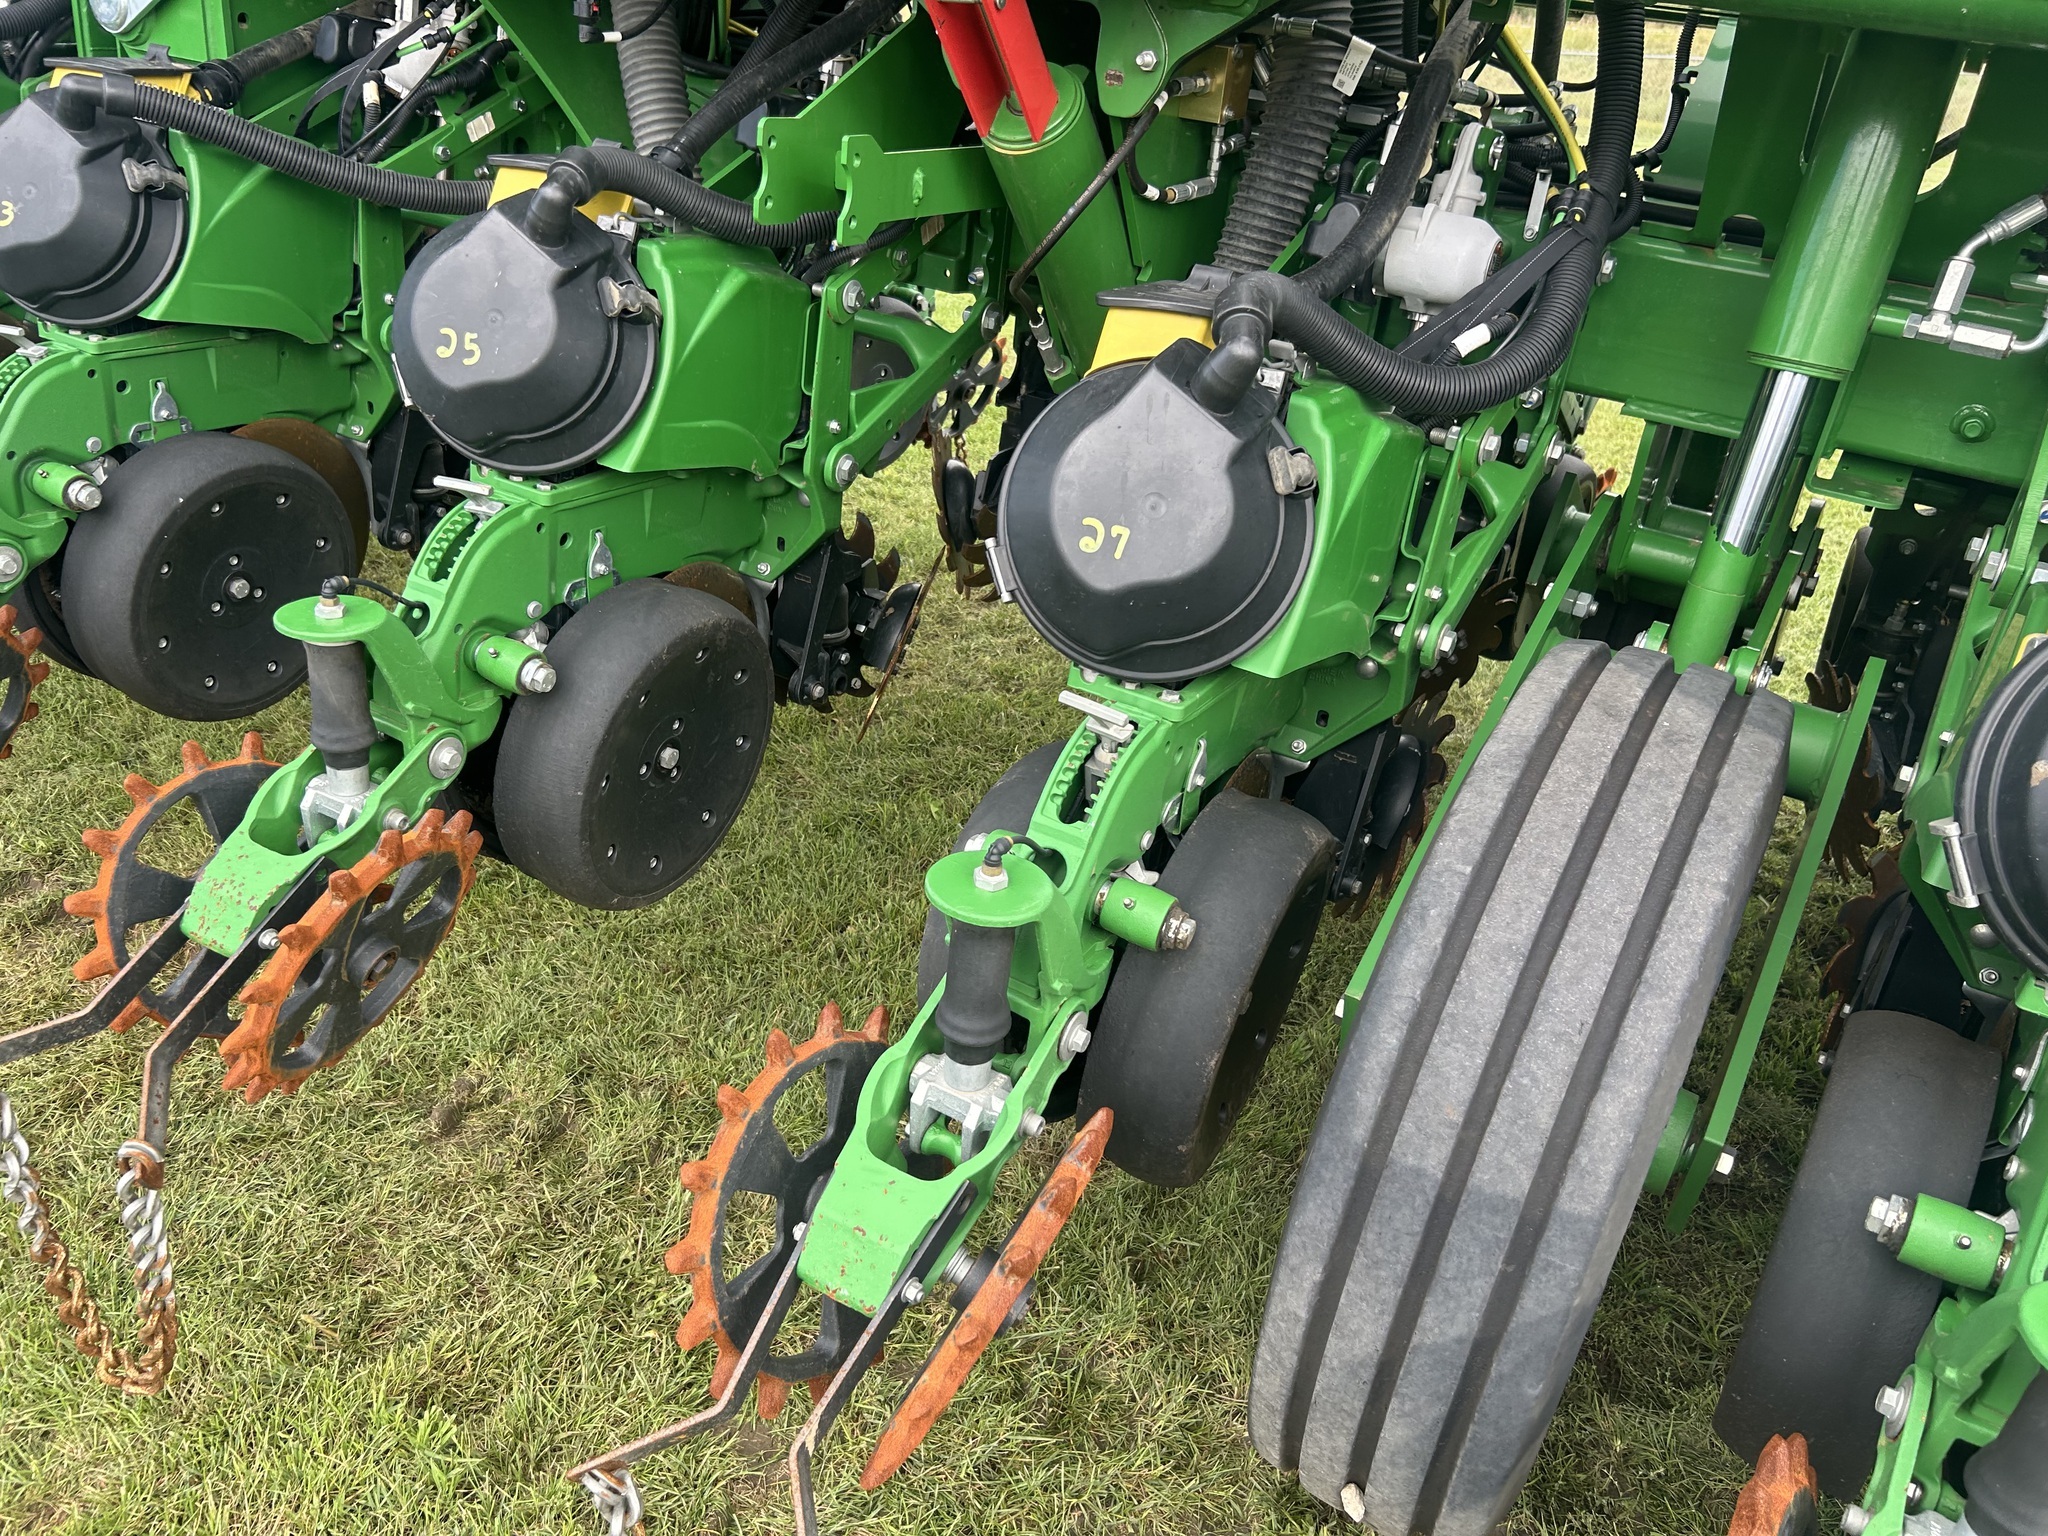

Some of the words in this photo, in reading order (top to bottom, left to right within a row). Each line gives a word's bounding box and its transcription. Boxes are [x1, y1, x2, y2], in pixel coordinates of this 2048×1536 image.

[0, 200, 15, 227] 3
[436, 327, 481, 366] 25
[1078, 516, 1131, 560] 27
